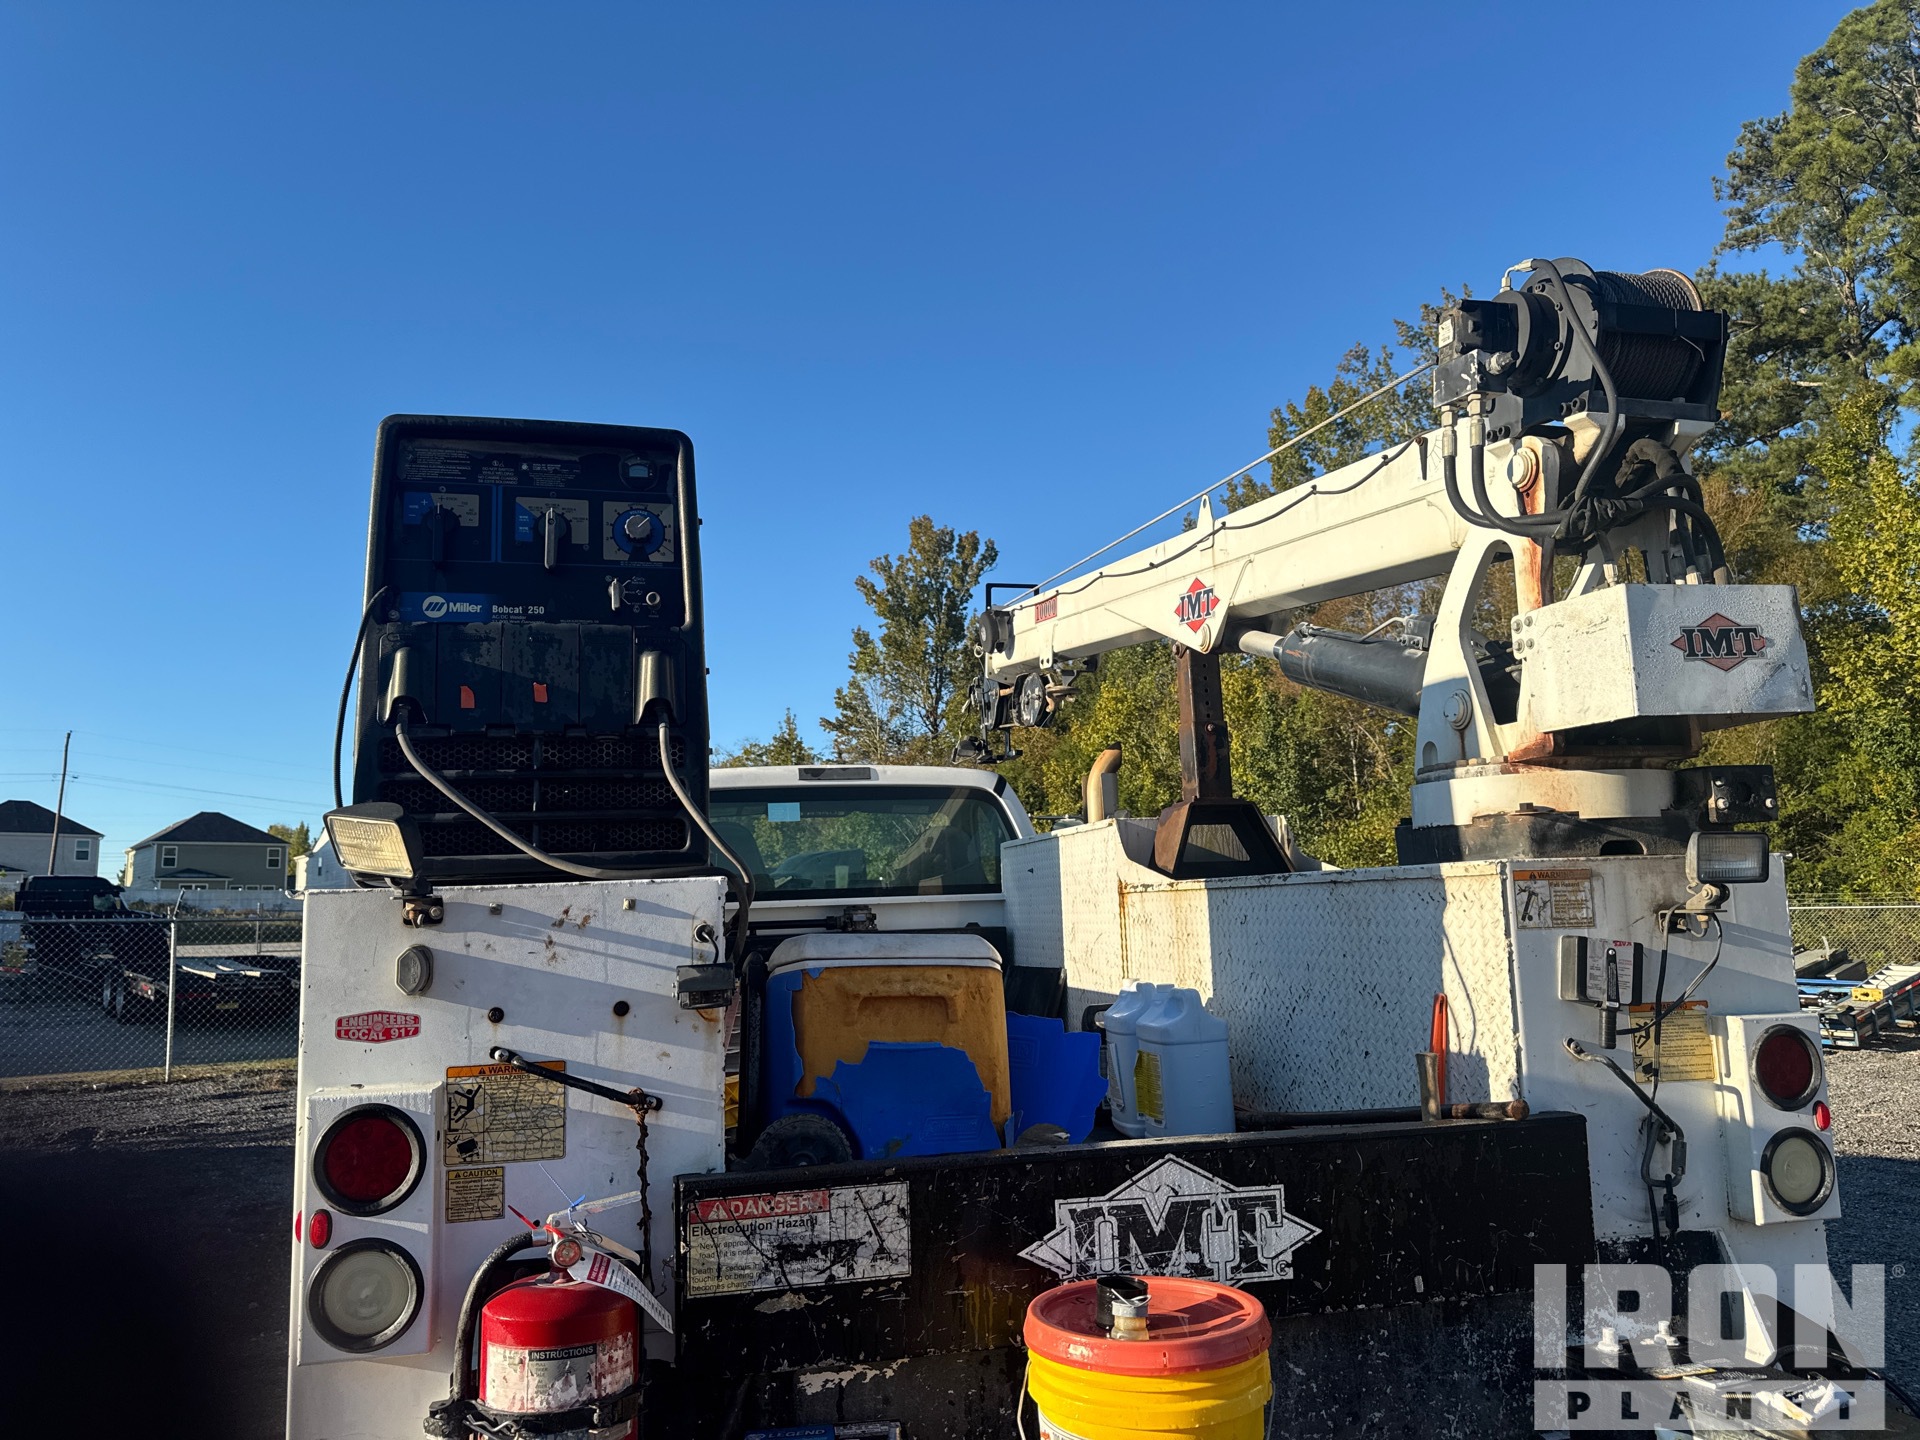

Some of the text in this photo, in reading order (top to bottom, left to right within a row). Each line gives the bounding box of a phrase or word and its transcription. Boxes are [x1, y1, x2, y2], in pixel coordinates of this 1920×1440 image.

[449, 602, 482, 613] Miller
[492, 605, 544, 616] Bobcat 250
[1035, 599, 1057, 621] 10000
[1179, 588, 1215, 622] IMT
[1682, 627, 1759, 658] IMT
[341, 1013, 415, 1027] ENGINEERS
[341, 1028, 416, 1041] LOCAL 917
[462, 1169, 498, 1178] CAUTION
[731, 1195, 813, 1217] DANGER
[1060, 1191, 1284, 1281] IMT
[691, 1267, 714, 1275] Death
[691, 1284, 725, 1292] becomes
[531, 1345, 595, 1359] INSTRUCTIONS
[768, 1429, 825, 1438] LEGEND
